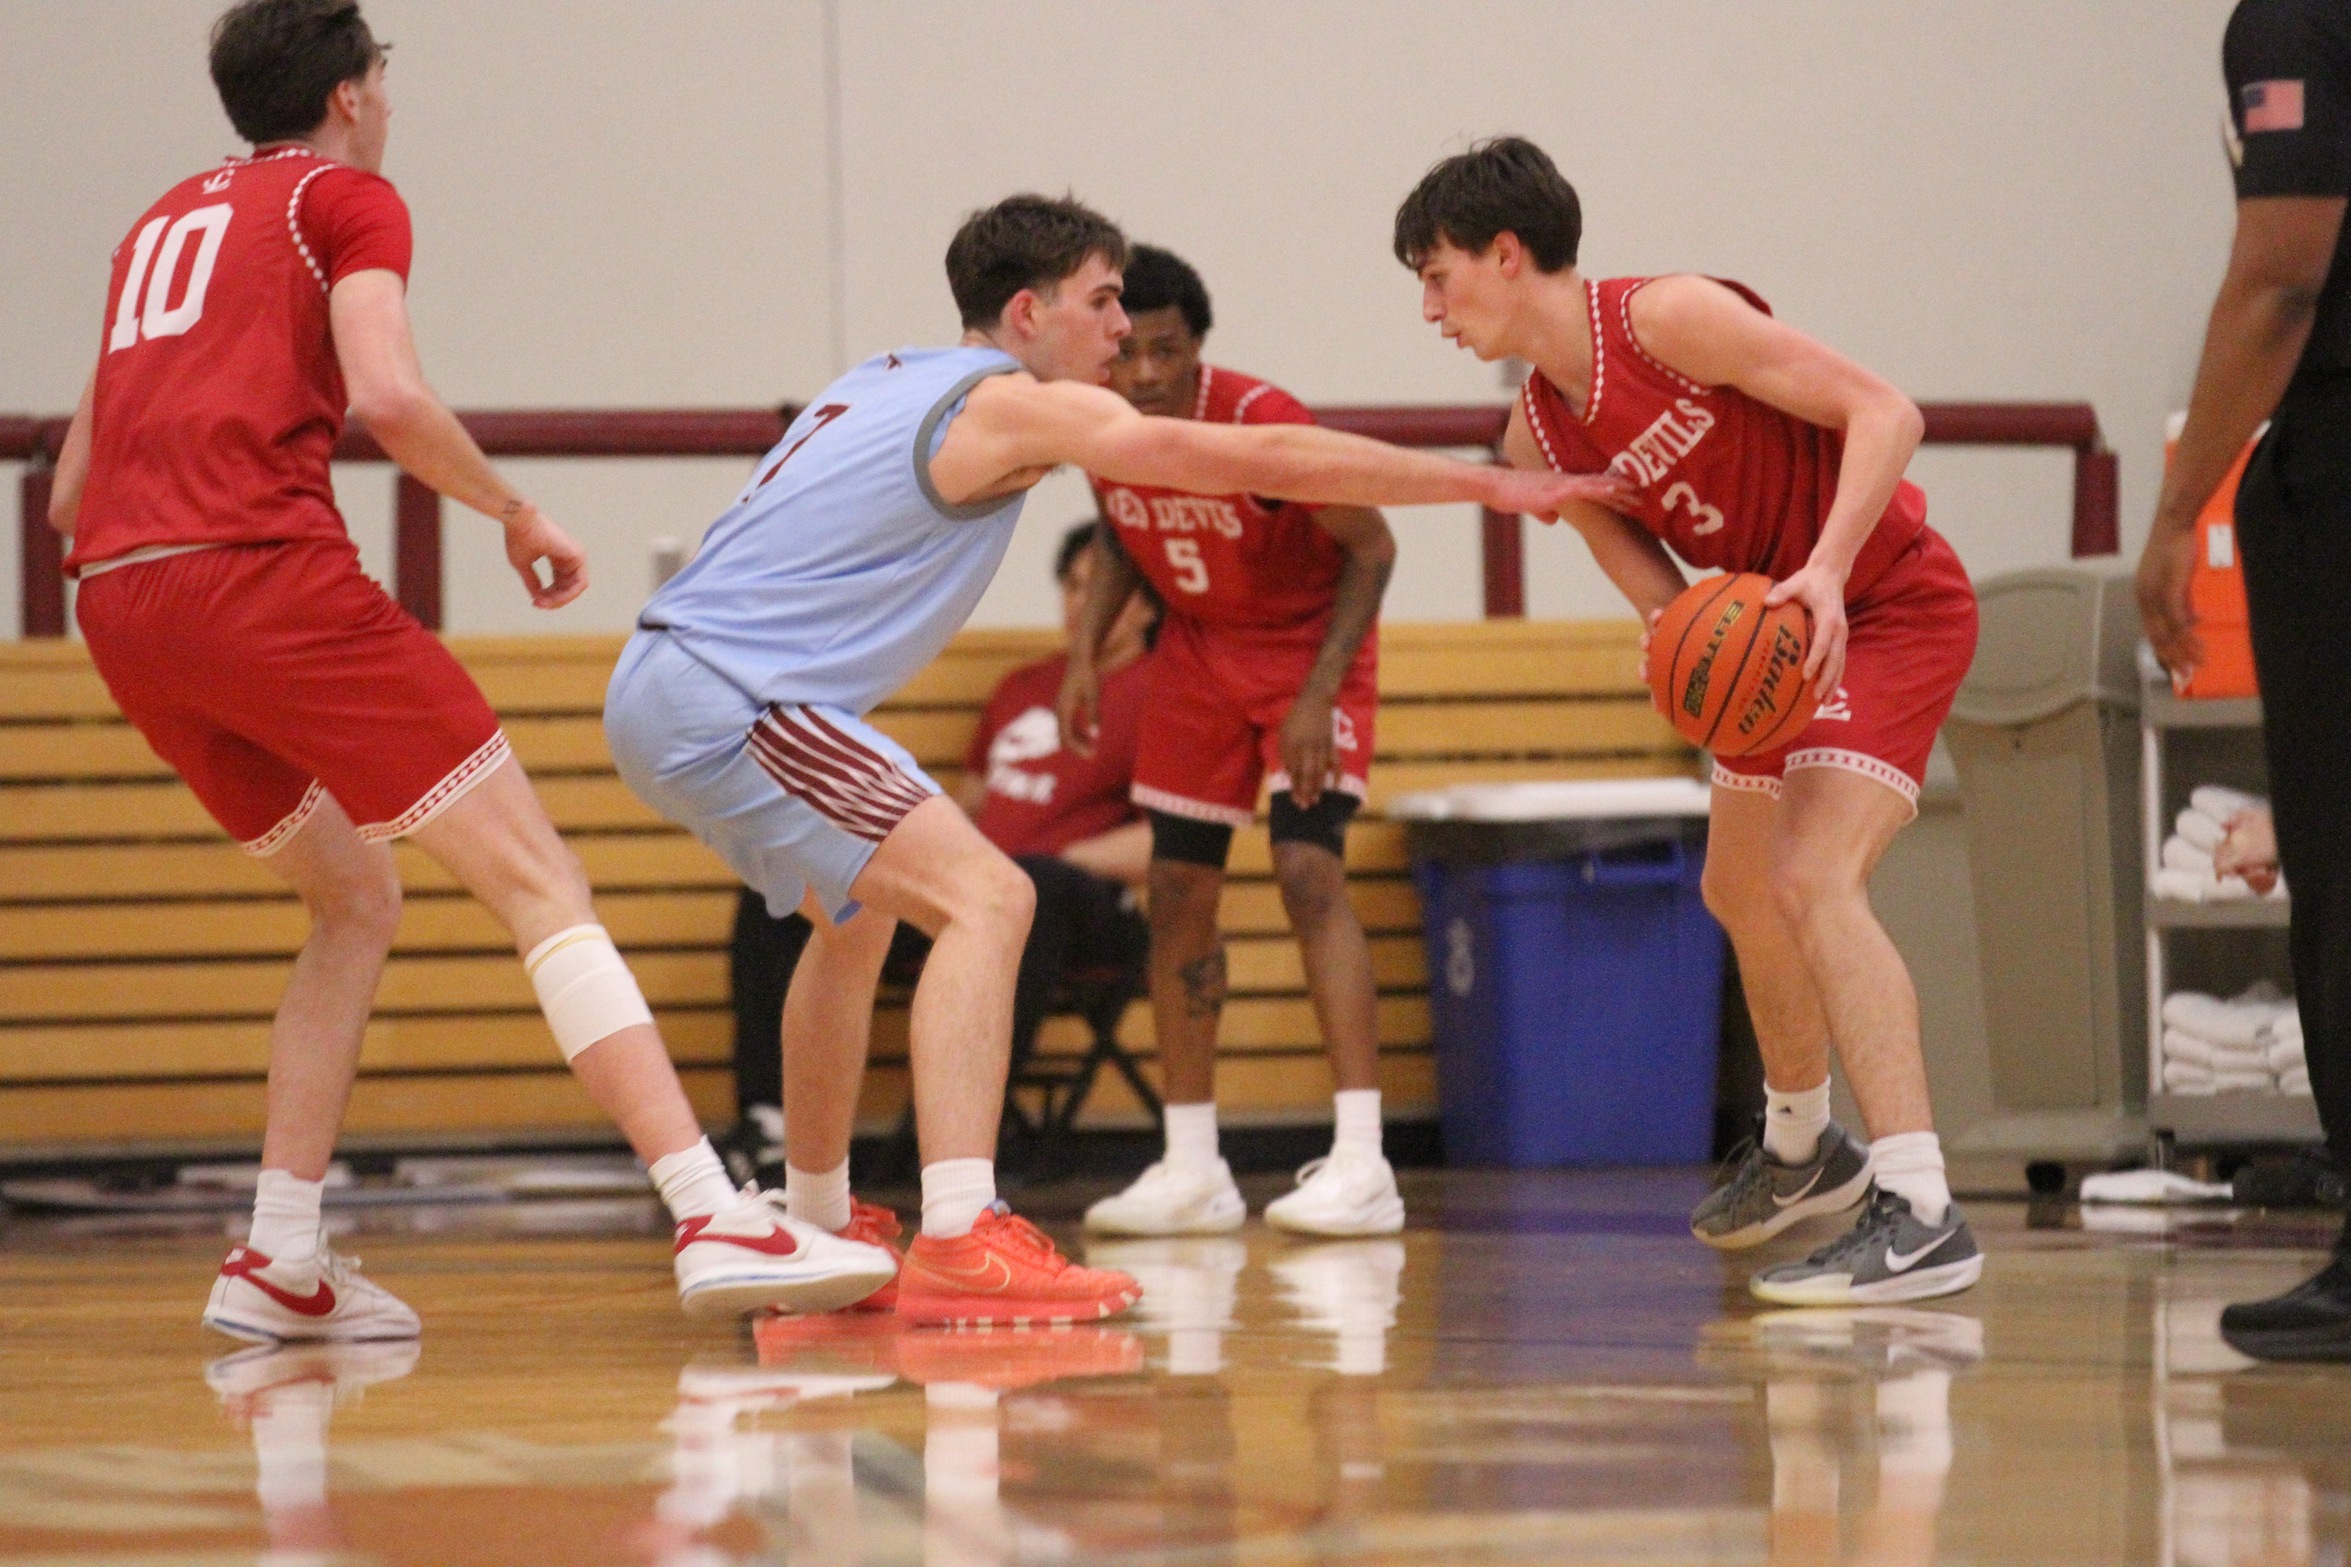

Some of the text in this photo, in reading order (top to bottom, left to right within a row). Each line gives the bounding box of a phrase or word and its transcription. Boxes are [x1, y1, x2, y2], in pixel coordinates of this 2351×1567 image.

[108, 203, 234, 356] 10
[1610, 397, 1715, 488] DEVILS
[1661, 481, 1724, 536] 3
[1164, 538, 1210, 593] 5
[1738, 624, 1801, 734] Baden
